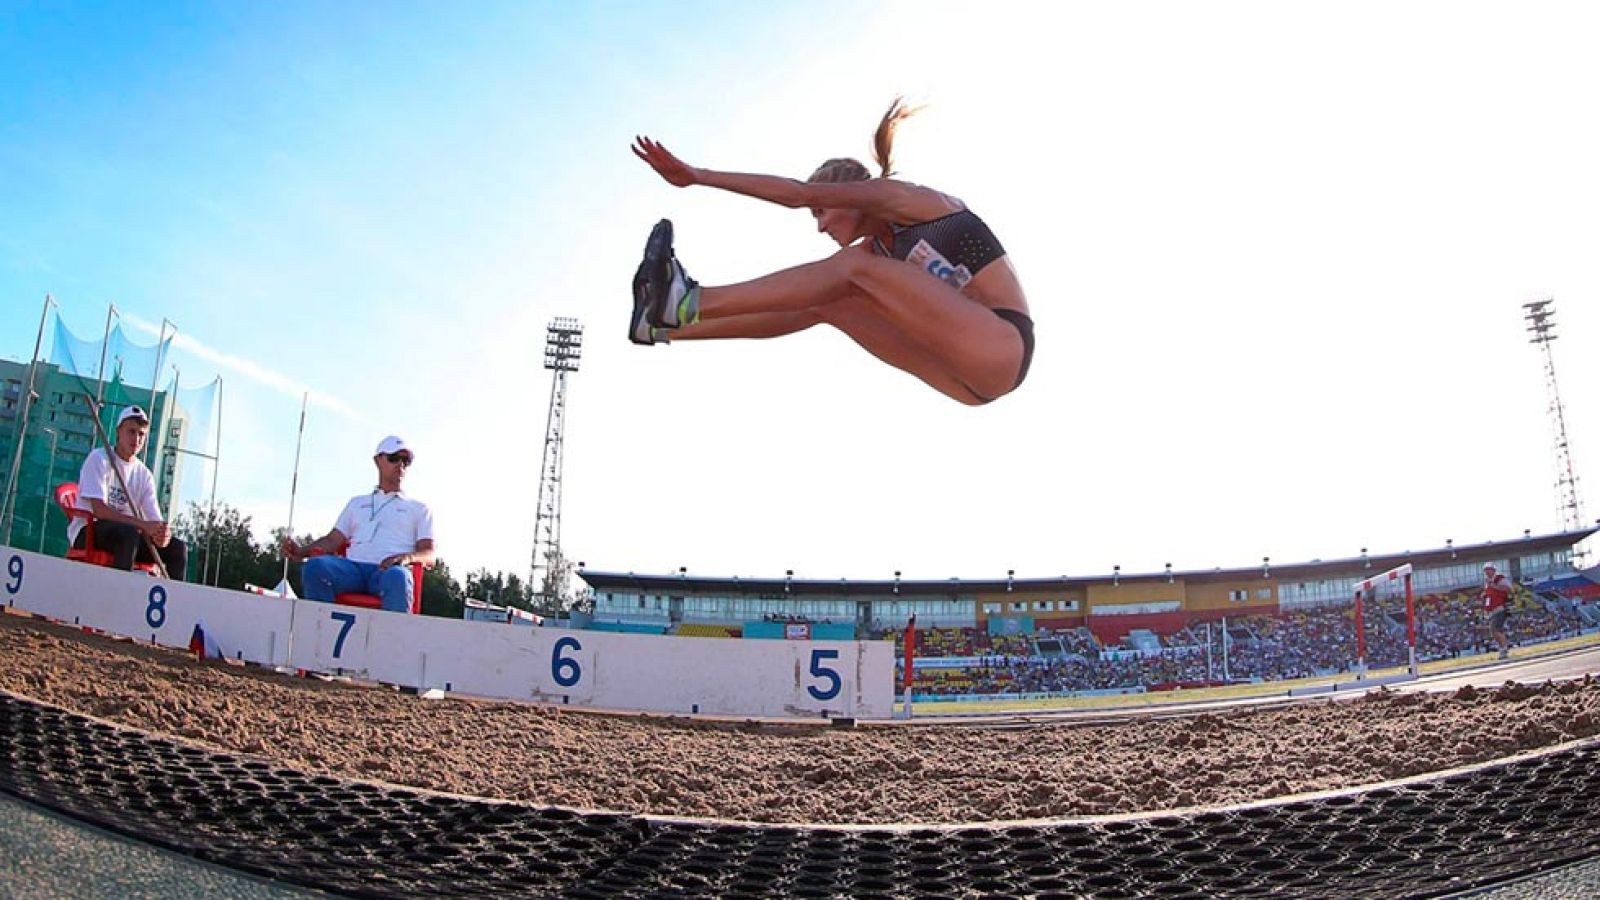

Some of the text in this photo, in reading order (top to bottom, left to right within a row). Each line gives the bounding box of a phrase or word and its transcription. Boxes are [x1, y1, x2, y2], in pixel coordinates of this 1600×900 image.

[6, 555, 23, 595] 9
[146, 585, 167, 629] 8
[331, 611, 356, 658] 7
[552, 636, 582, 687] 6
[807, 649, 842, 700] 5
